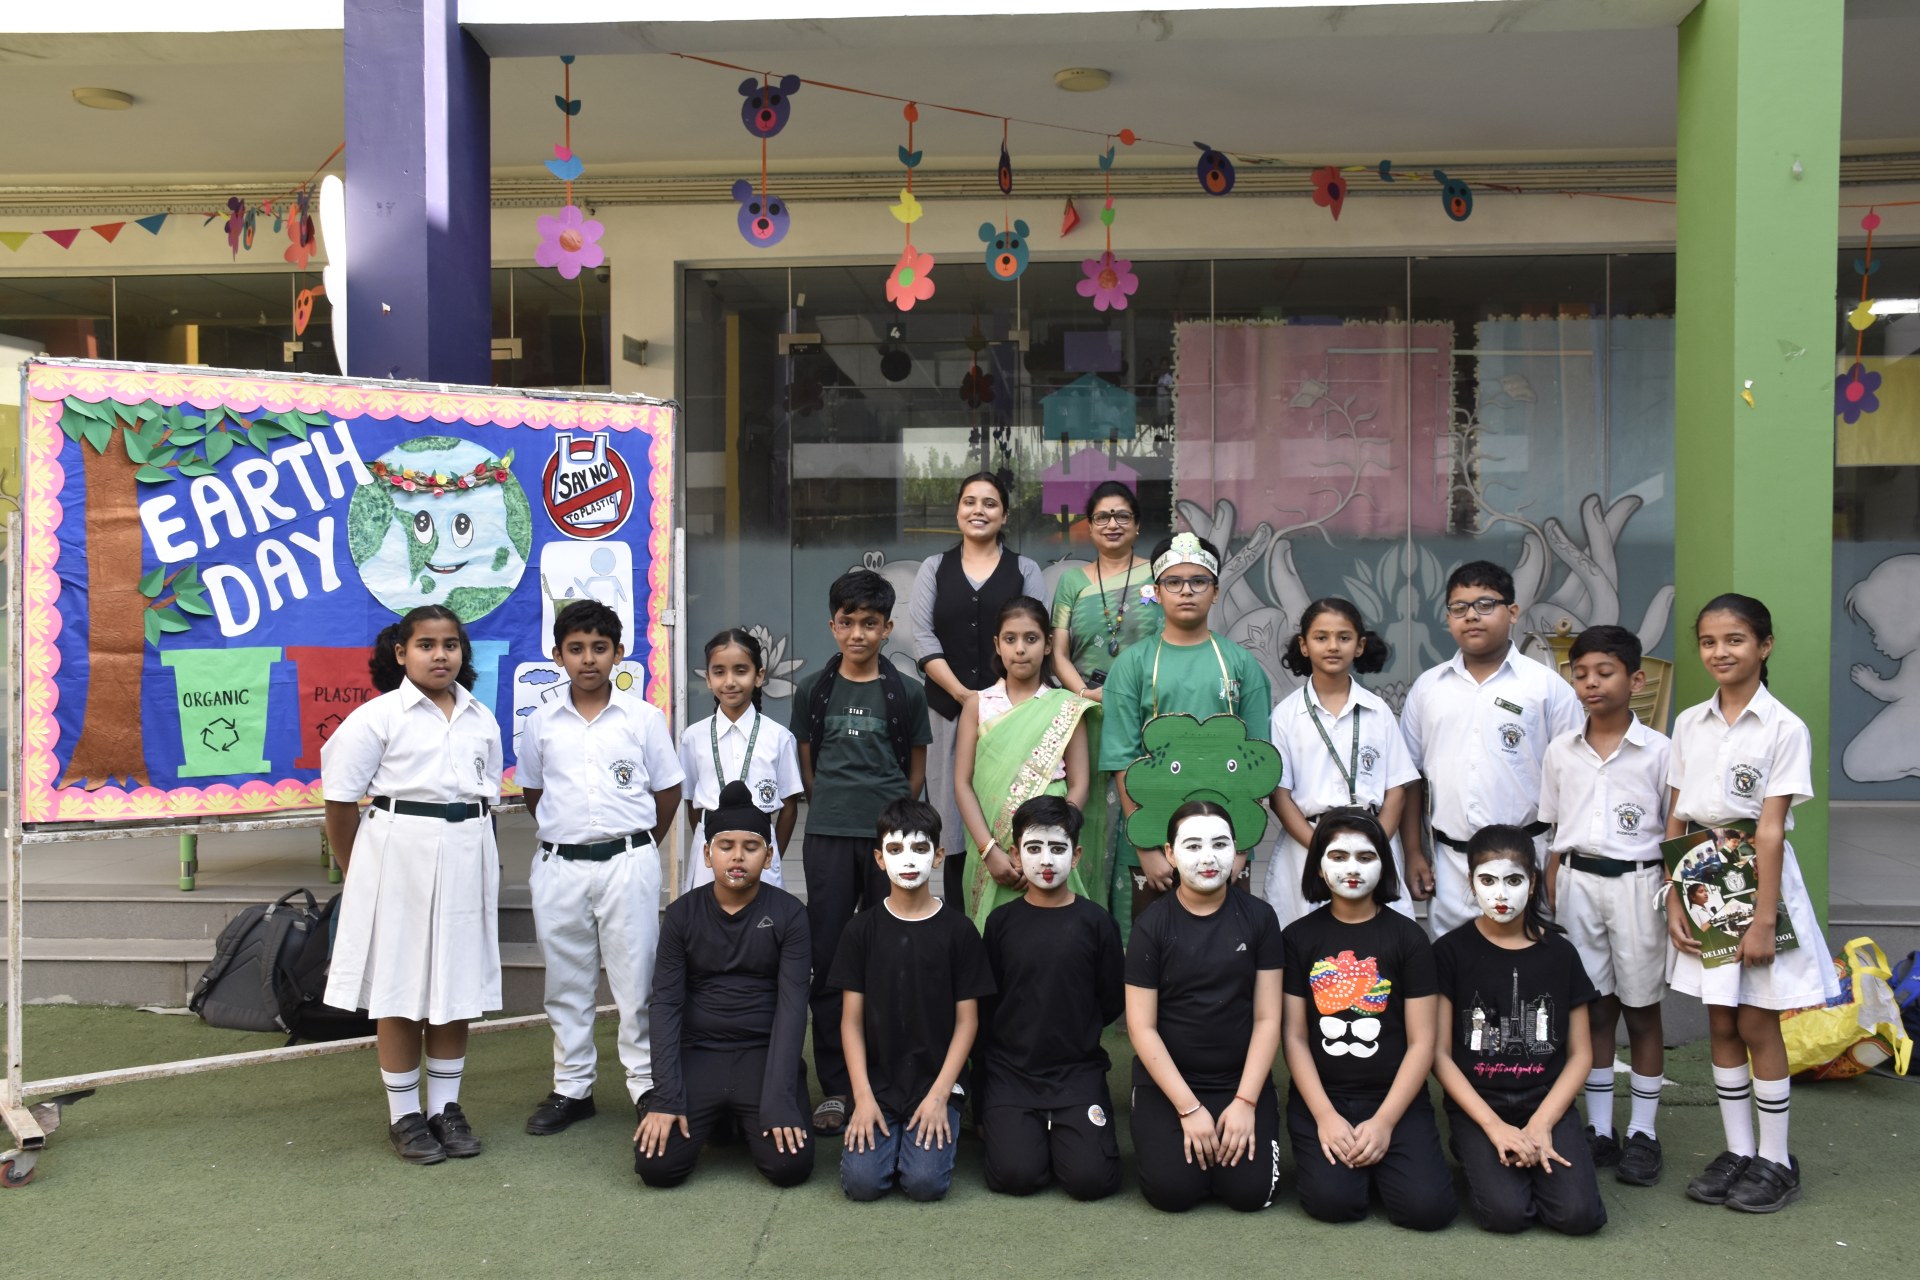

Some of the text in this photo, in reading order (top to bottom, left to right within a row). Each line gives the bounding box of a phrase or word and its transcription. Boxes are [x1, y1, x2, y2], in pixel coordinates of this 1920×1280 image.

[139, 421, 374, 563] EARTH
[558, 462, 609, 499] SAY NO
[566, 495, 616, 523] TO PLASTIC
[202, 516, 341, 637] DAY
[183, 689, 249, 708] ORGANIC
[314, 686, 372, 703] PLASTIC
[1702, 946, 1728, 959] DELHI
